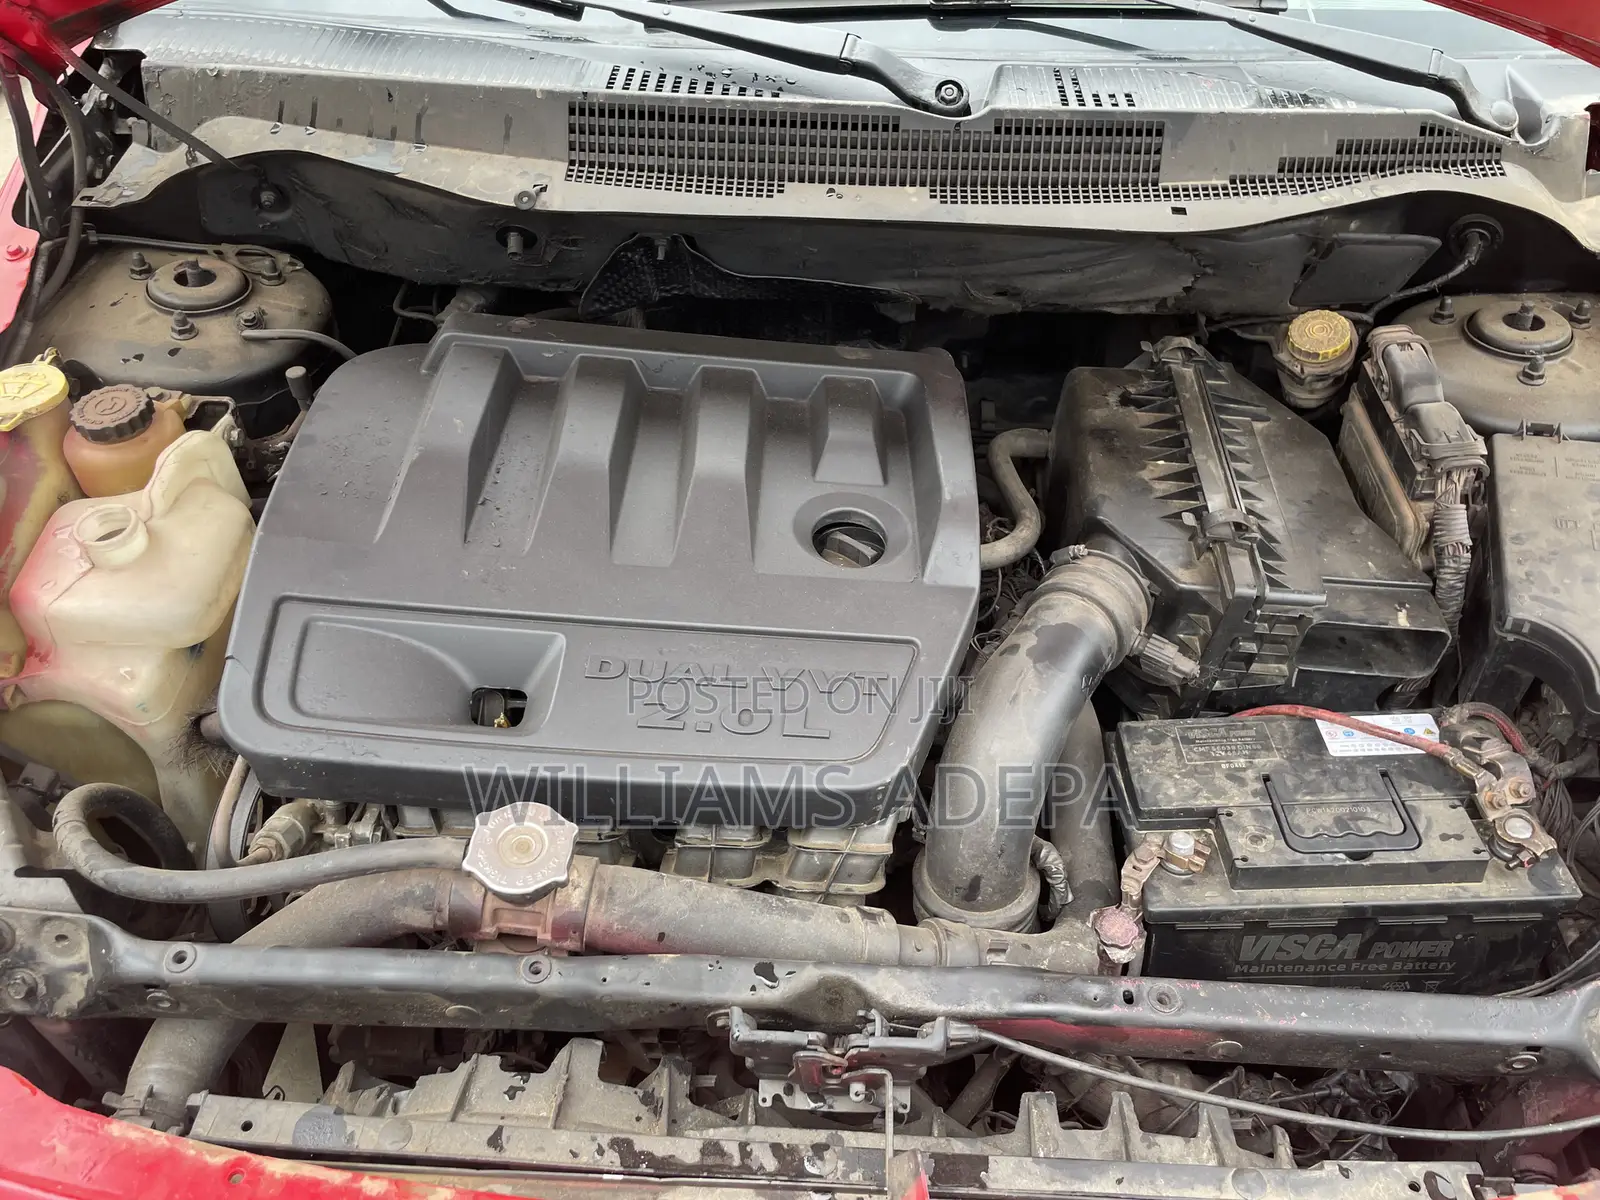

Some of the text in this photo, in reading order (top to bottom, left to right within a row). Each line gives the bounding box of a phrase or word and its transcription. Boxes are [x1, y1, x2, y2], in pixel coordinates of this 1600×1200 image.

[584, 655, 747, 688] DUAL
[1240, 933, 1454, 961] VISCA POWER
[1234, 960, 1456, 973] Maintenance Free Battery
